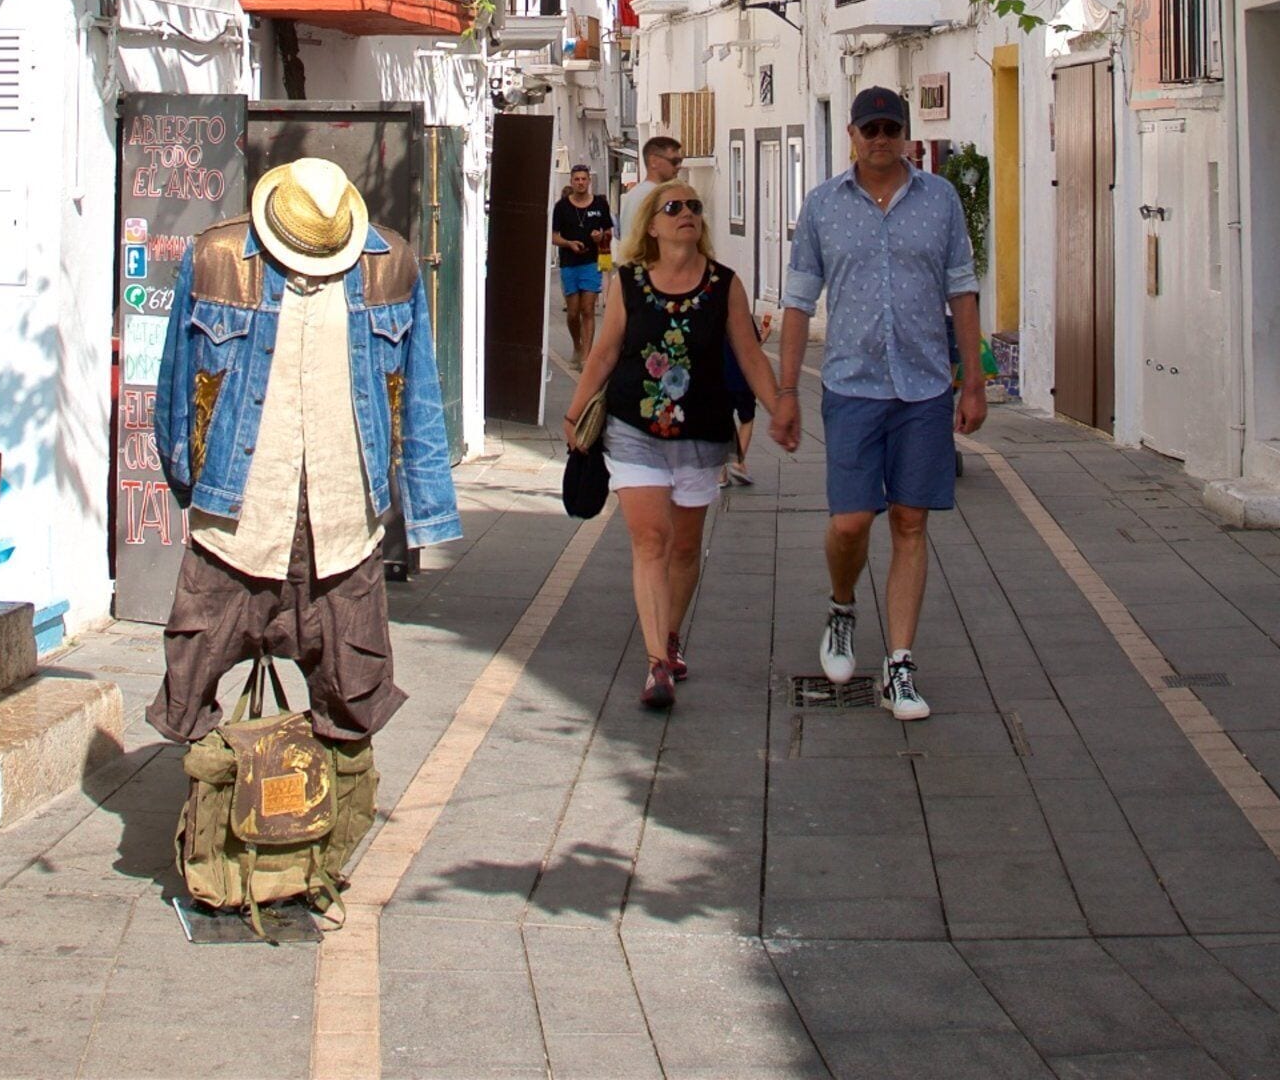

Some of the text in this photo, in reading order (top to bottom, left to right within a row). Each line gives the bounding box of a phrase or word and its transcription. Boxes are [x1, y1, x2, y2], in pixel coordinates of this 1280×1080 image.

[129, 115, 226, 145] ABIERTO
[144, 144, 203, 169] TODO
[132, 168, 225, 202] EL AÑO
